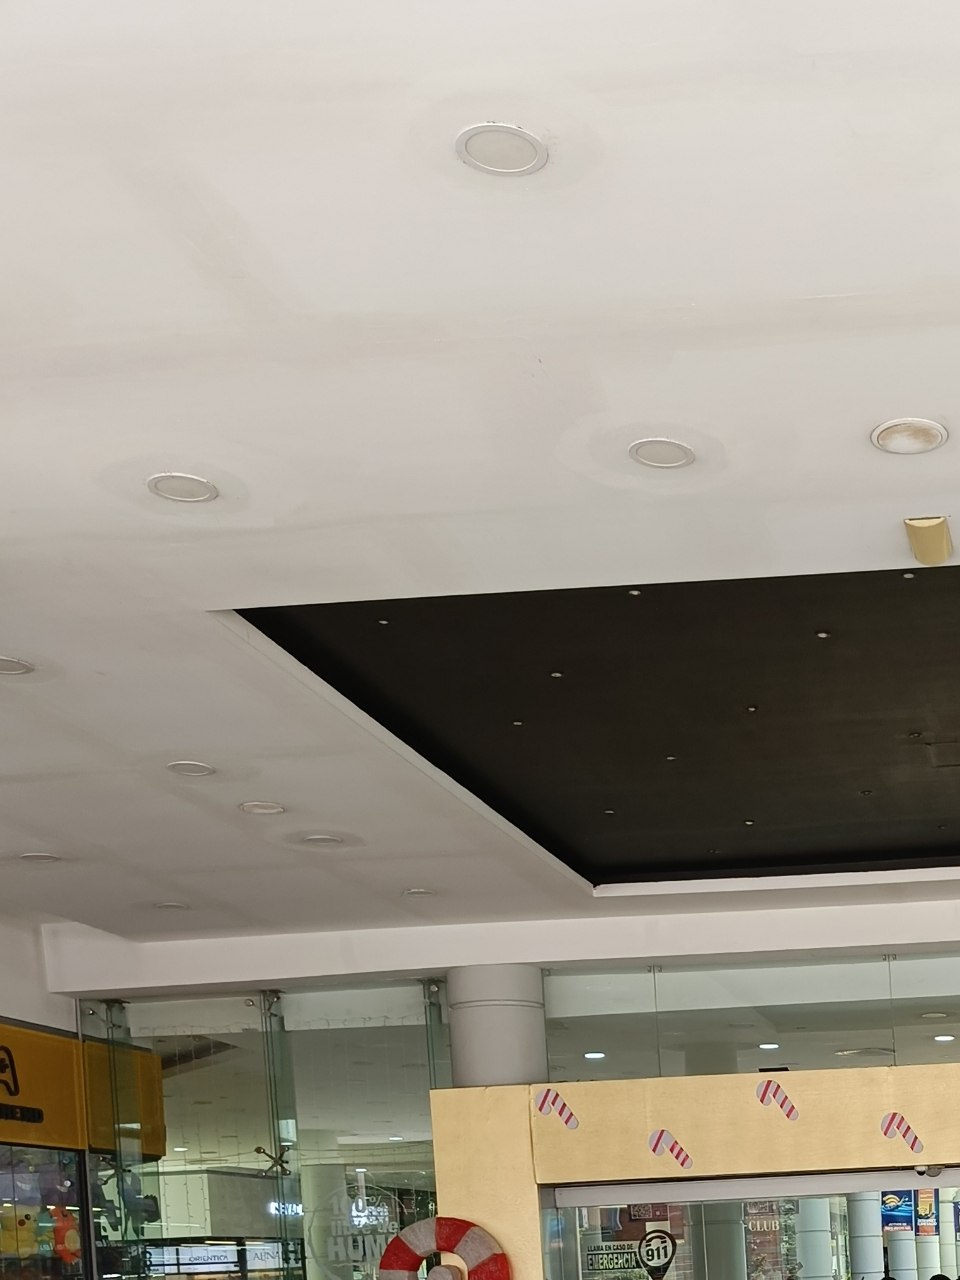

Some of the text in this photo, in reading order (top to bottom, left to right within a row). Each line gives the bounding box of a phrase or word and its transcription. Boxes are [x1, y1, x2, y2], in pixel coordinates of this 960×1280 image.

[748, 1220, 780, 1232] CLUB
[327, 1234, 389, 1261] HUM
[645, 1245, 668, 1262] 911
[587, 1252, 637, 1270] EMERGENCIA
